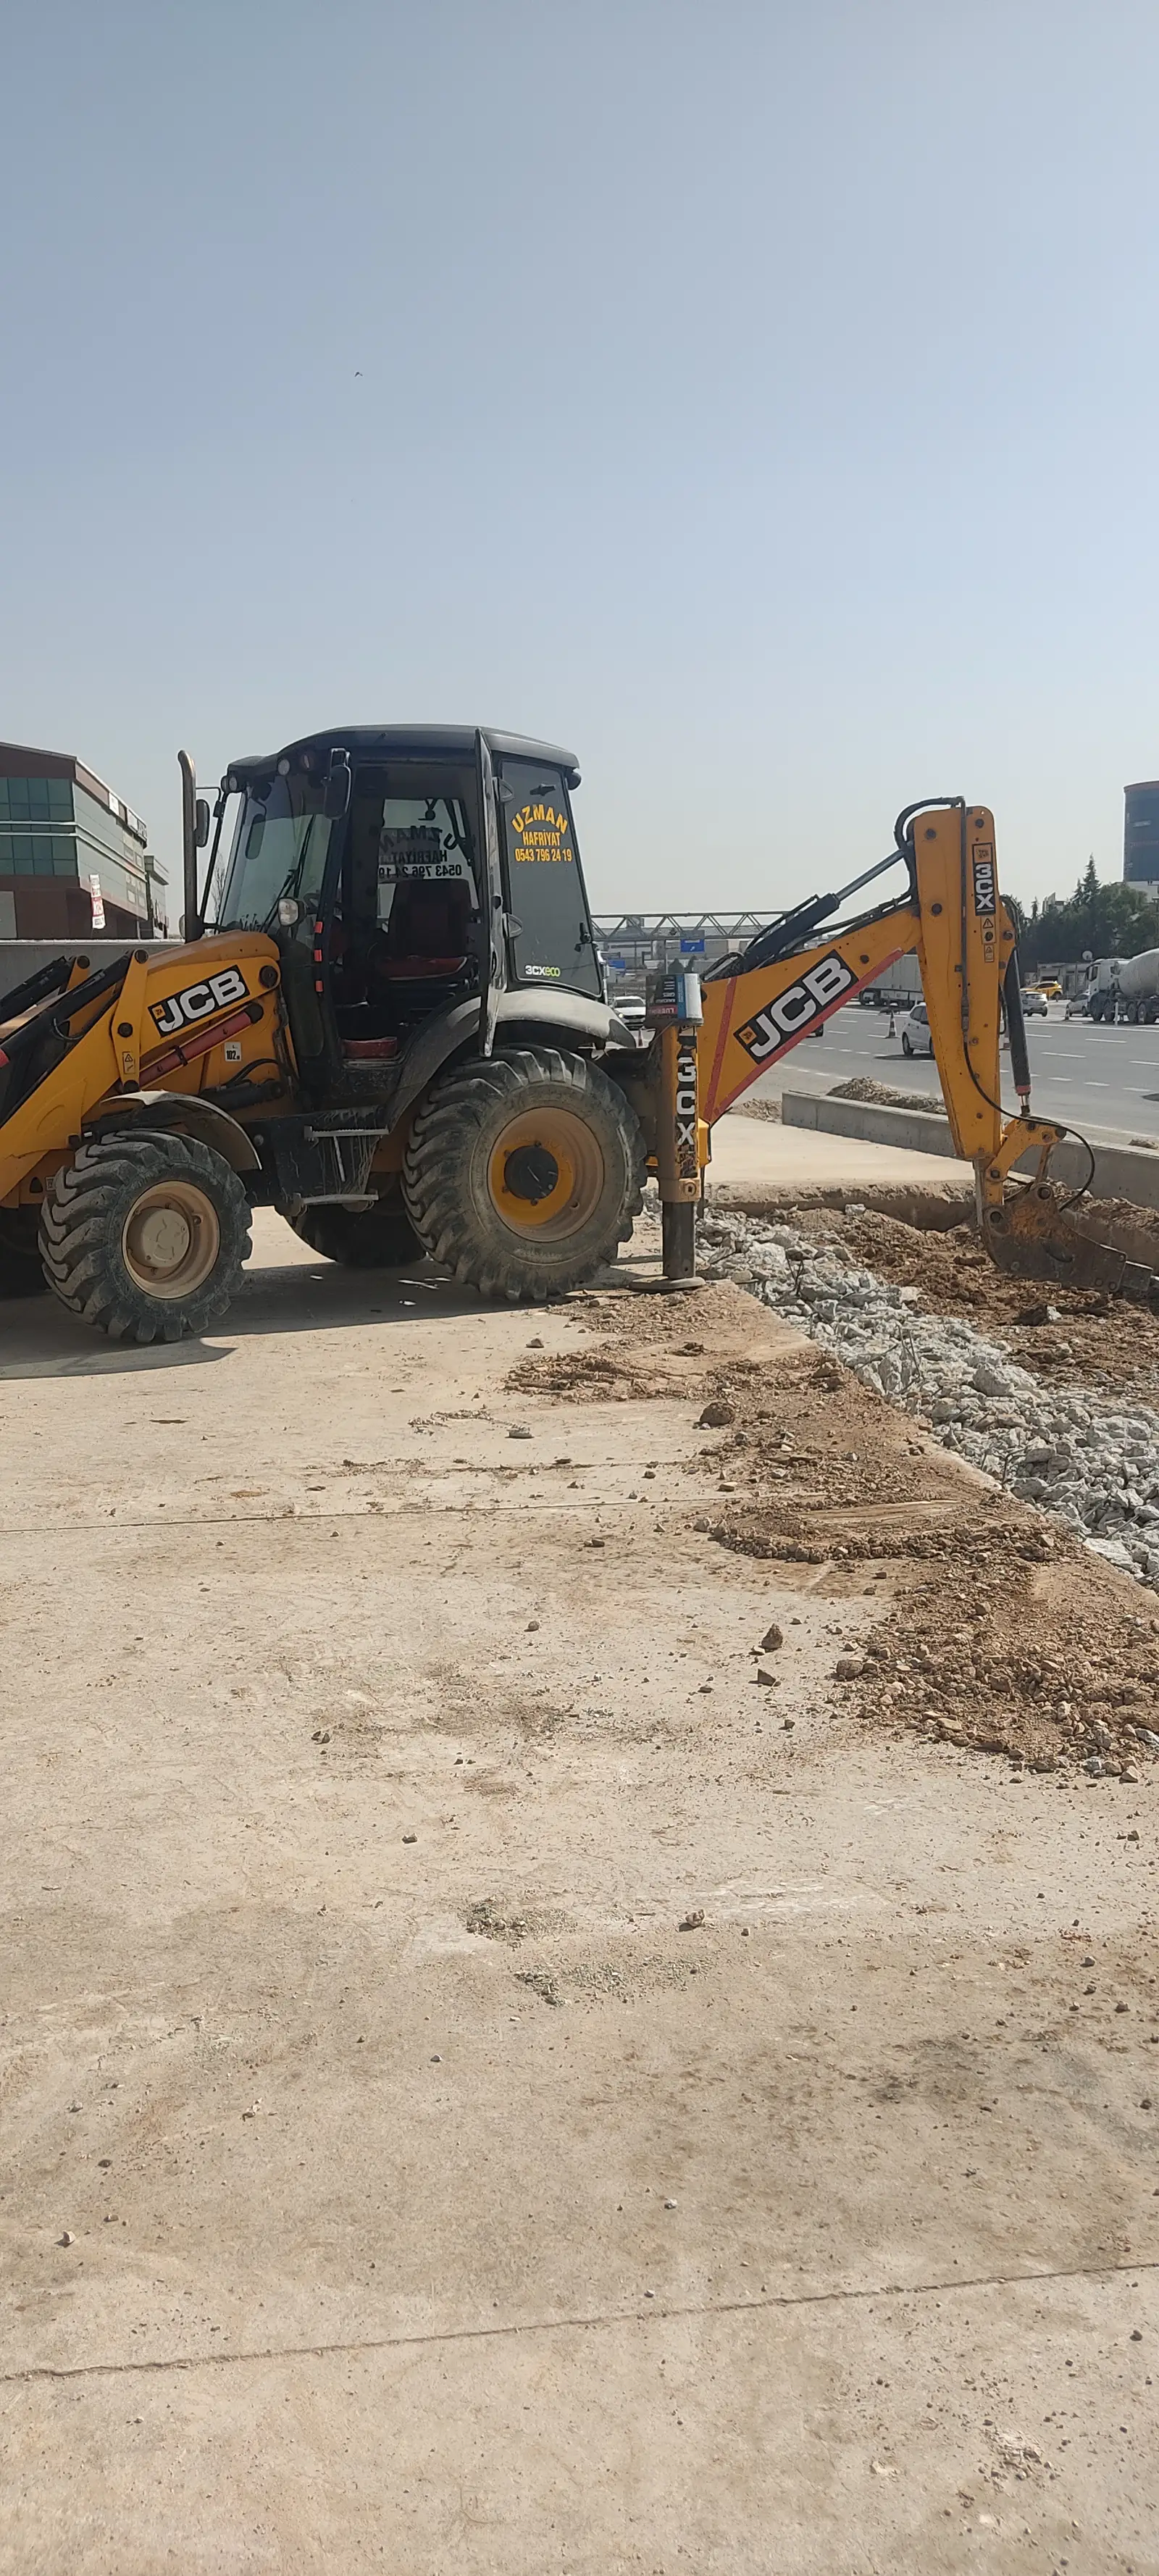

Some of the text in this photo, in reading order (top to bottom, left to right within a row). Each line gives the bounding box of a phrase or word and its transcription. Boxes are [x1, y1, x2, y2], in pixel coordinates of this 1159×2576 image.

[511, 804, 568, 835] UZMAN
[522, 829, 561, 846] HAFRİYAT
[515, 848, 572, 862] 0543 796 24 19
[975, 863, 995, 910] 3CX
[158, 970, 246, 1032] JCB
[750, 958, 852, 1057] JCB
[226, 1050, 236, 1060] 102
